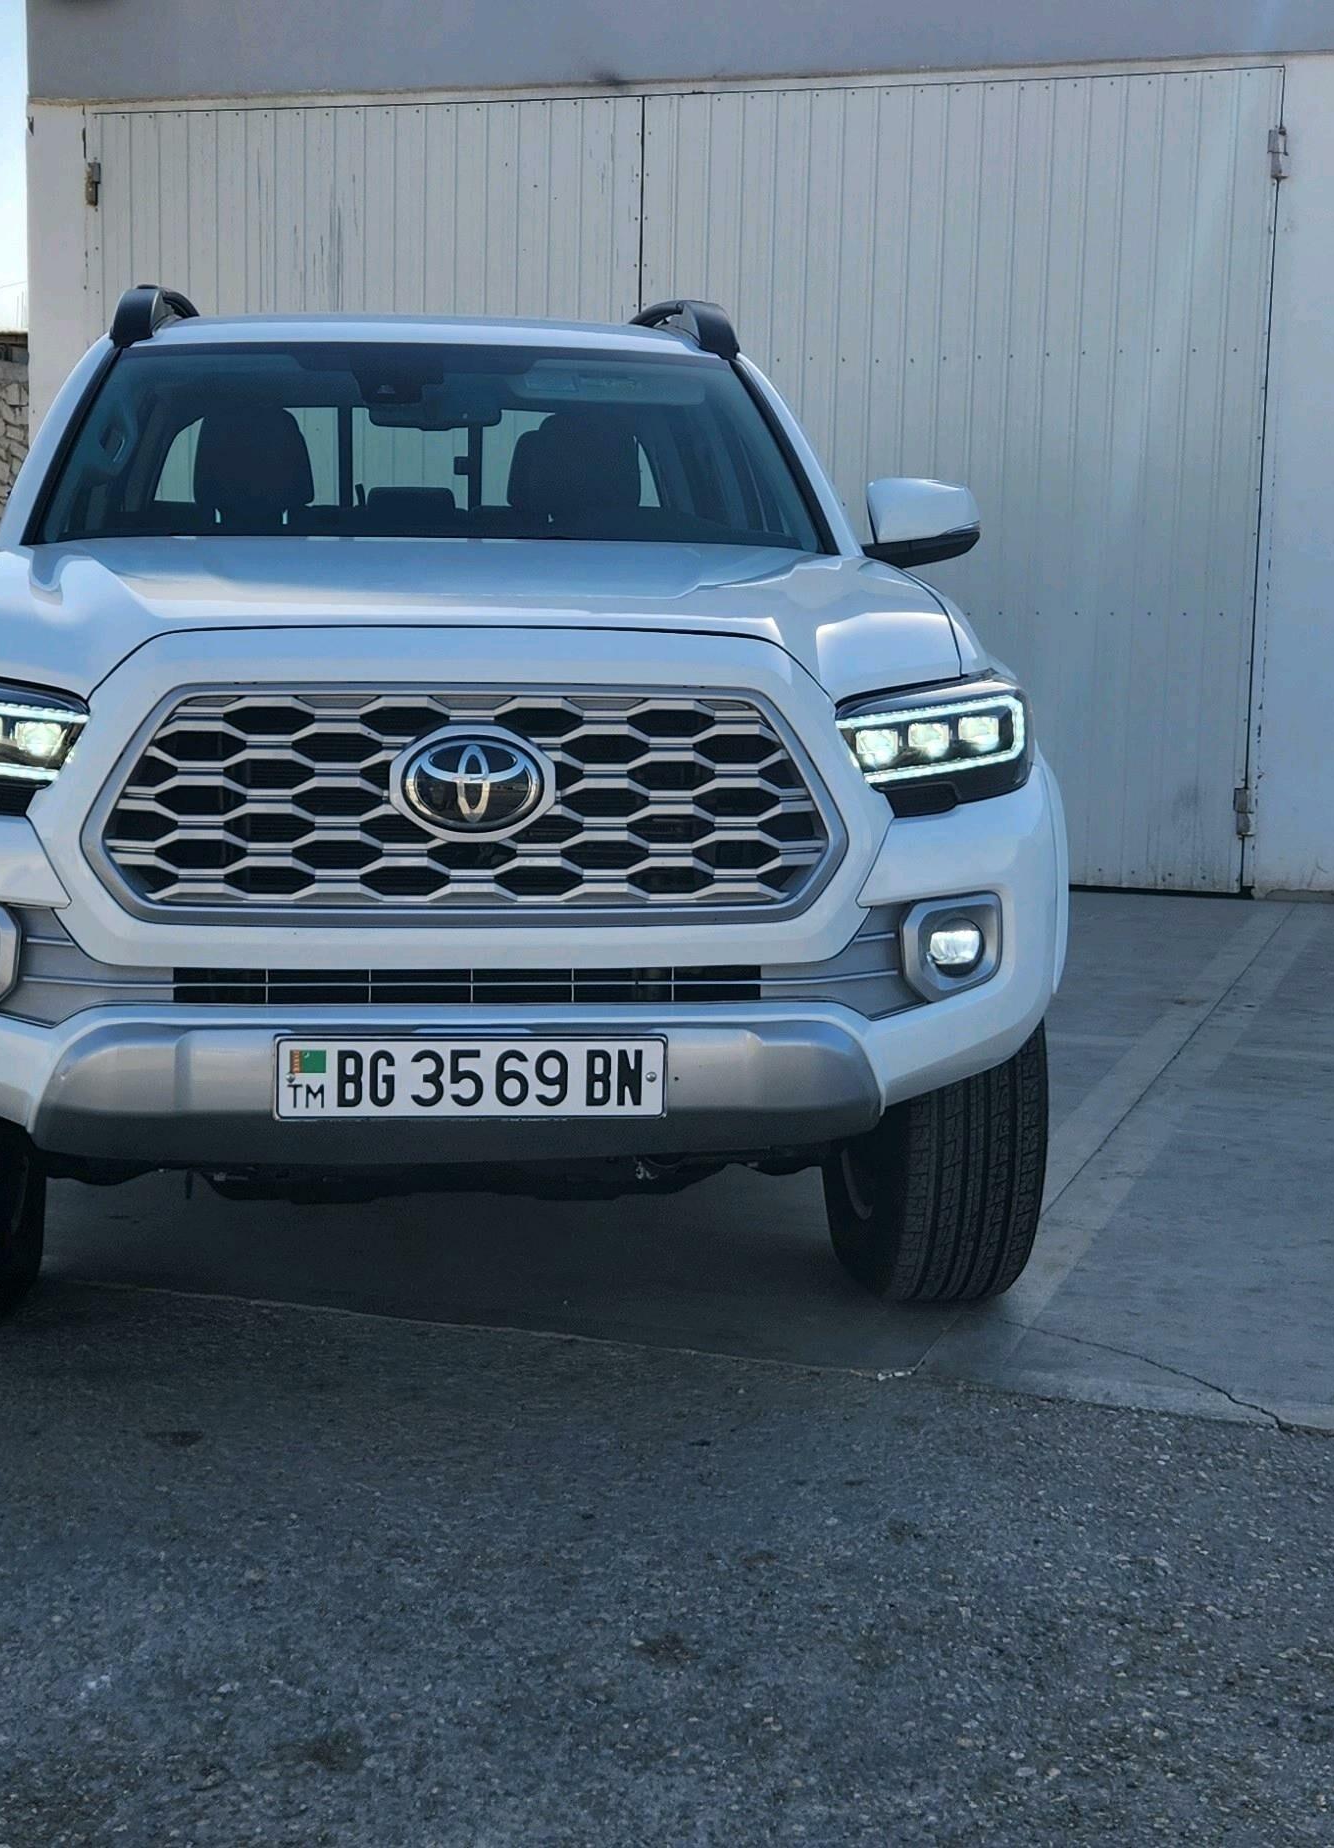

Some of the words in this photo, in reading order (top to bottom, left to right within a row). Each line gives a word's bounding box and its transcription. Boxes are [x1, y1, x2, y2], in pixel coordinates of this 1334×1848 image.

[287, 1084, 325, 1108] TM
[337, 1049, 395, 1108] BG
[586, 1049, 643, 1107] BN
